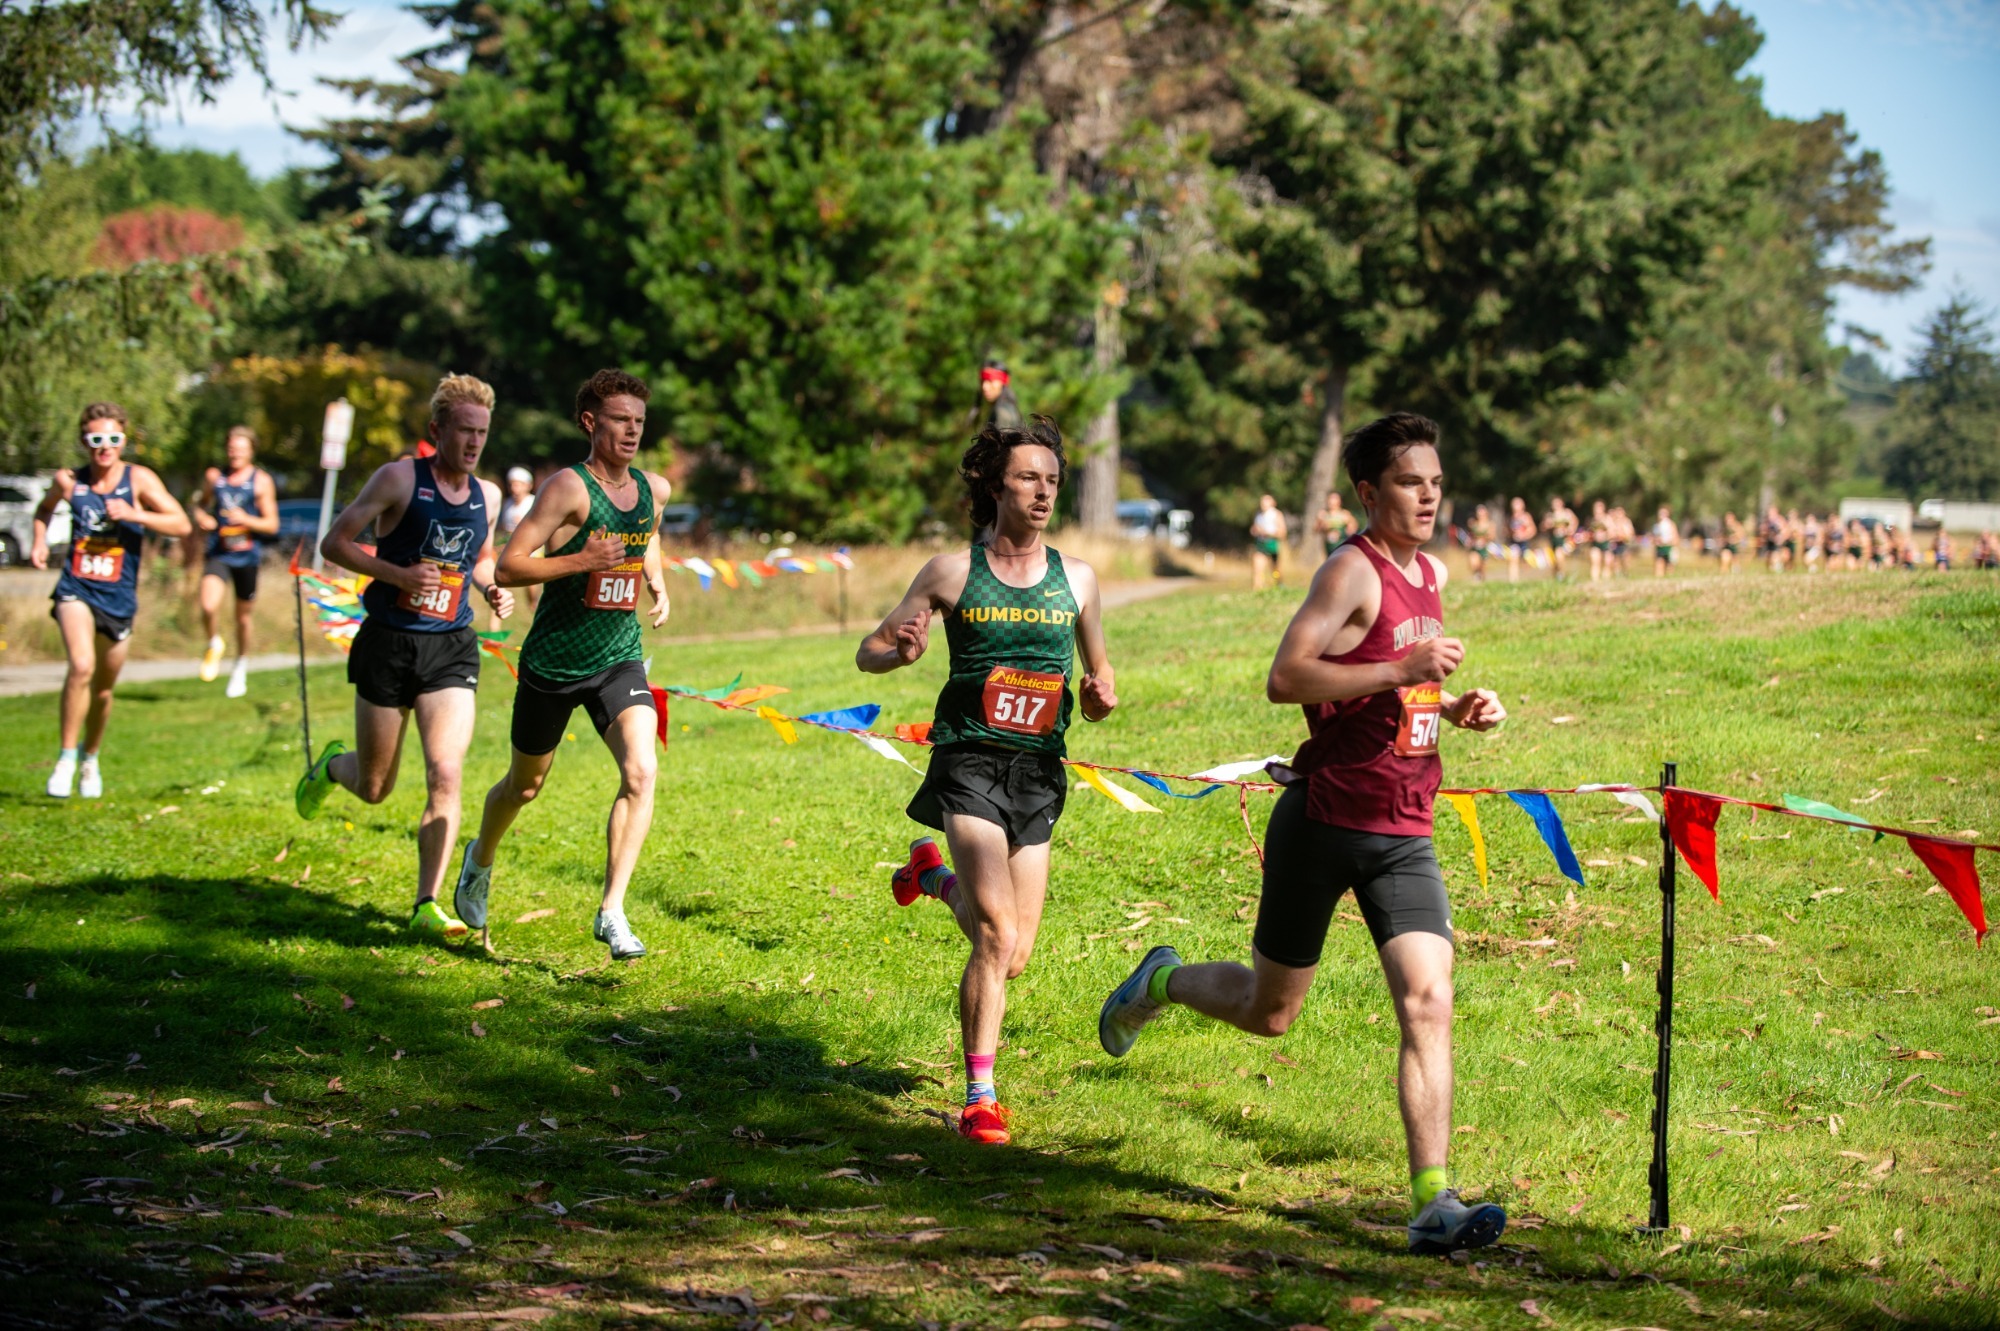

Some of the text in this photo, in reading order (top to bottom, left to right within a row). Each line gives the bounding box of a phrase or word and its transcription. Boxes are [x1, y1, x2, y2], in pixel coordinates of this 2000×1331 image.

[598, 577, 635, 603] 504
[962, 607, 1075, 626] HUMBOLDT
[994, 692, 1046, 725] 517
[1410, 713, 1440, 746] 574
